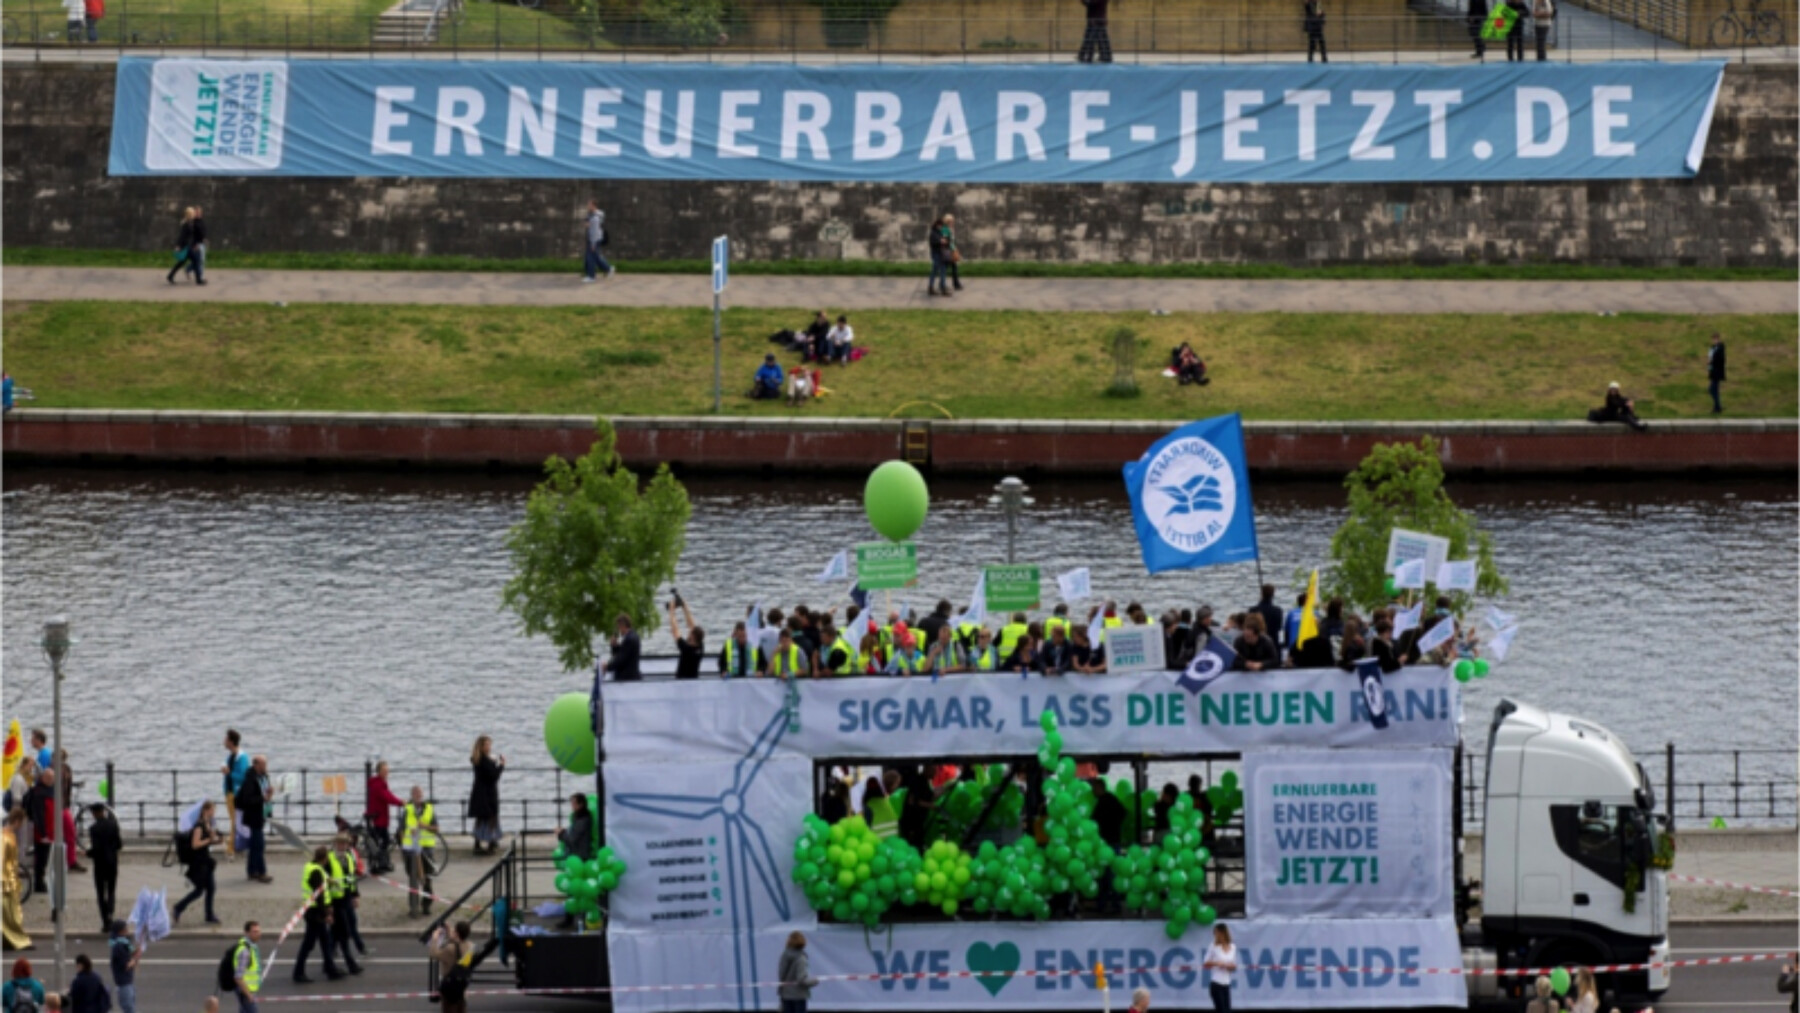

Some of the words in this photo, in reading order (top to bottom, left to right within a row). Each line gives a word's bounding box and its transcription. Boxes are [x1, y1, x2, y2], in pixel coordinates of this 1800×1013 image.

[192, 72, 219, 156] JETZT!
[217, 74, 241, 156] WENDE
[238, 73, 259, 156] ENERGIE
[371, 85, 1636, 178] ERNEUERBARE-JETZT.DE
[838, 695, 1005, 733] SIGMAR,
[1021, 694, 1113, 728] LASS
[1127, 693, 1185, 726] DIE
[1201, 690, 1334, 726] NEUEN
[1273, 783, 1377, 797] ERNEUERBARE
[1273, 801, 1378, 824] ENERGIE
[1275, 827, 1379, 850] WENDE
[1276, 855, 1379, 886] JETZT!
[872, 949, 950, 991] WE
[1035, 946, 1420, 989] ENERGIWENDE
